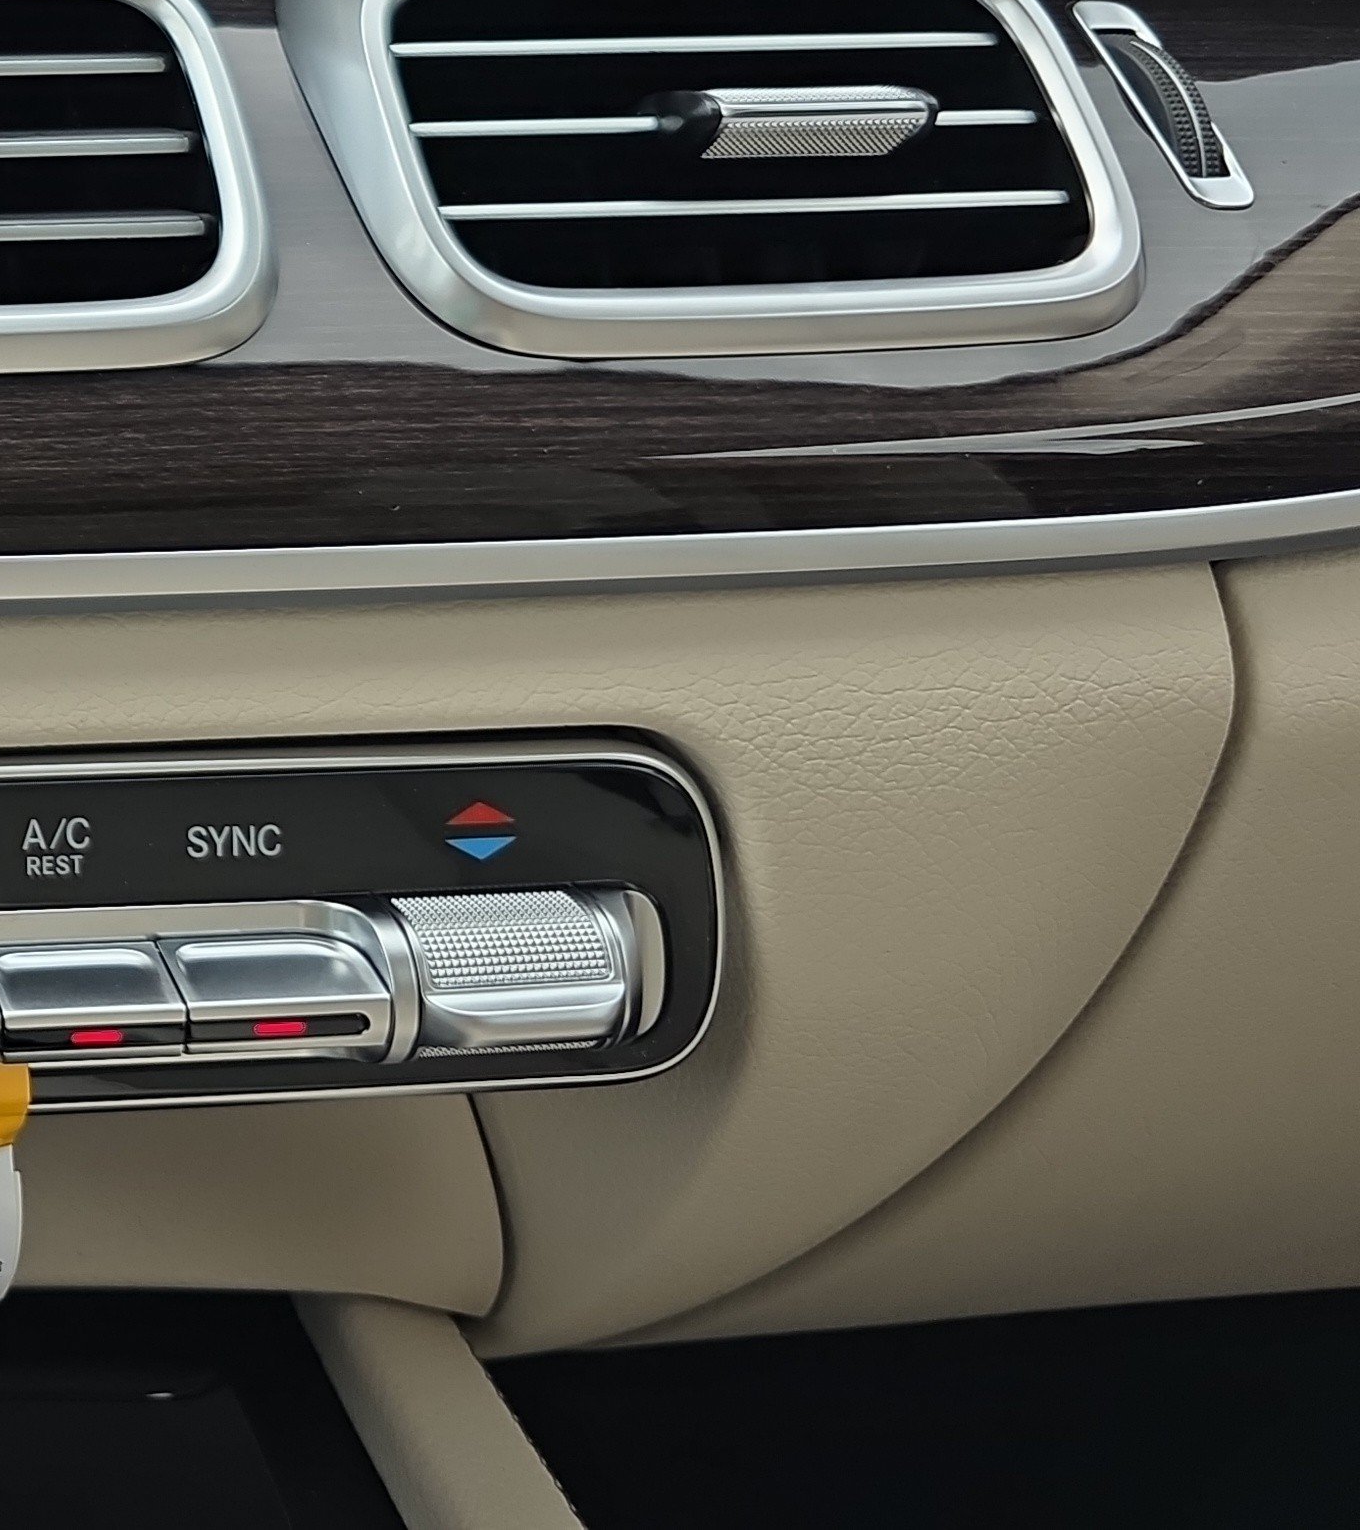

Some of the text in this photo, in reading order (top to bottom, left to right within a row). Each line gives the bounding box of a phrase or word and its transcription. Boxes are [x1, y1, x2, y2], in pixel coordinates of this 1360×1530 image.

[22, 816, 91, 851] A/C
[187, 823, 282, 860] SYNC
[26, 854, 84, 876] REST
